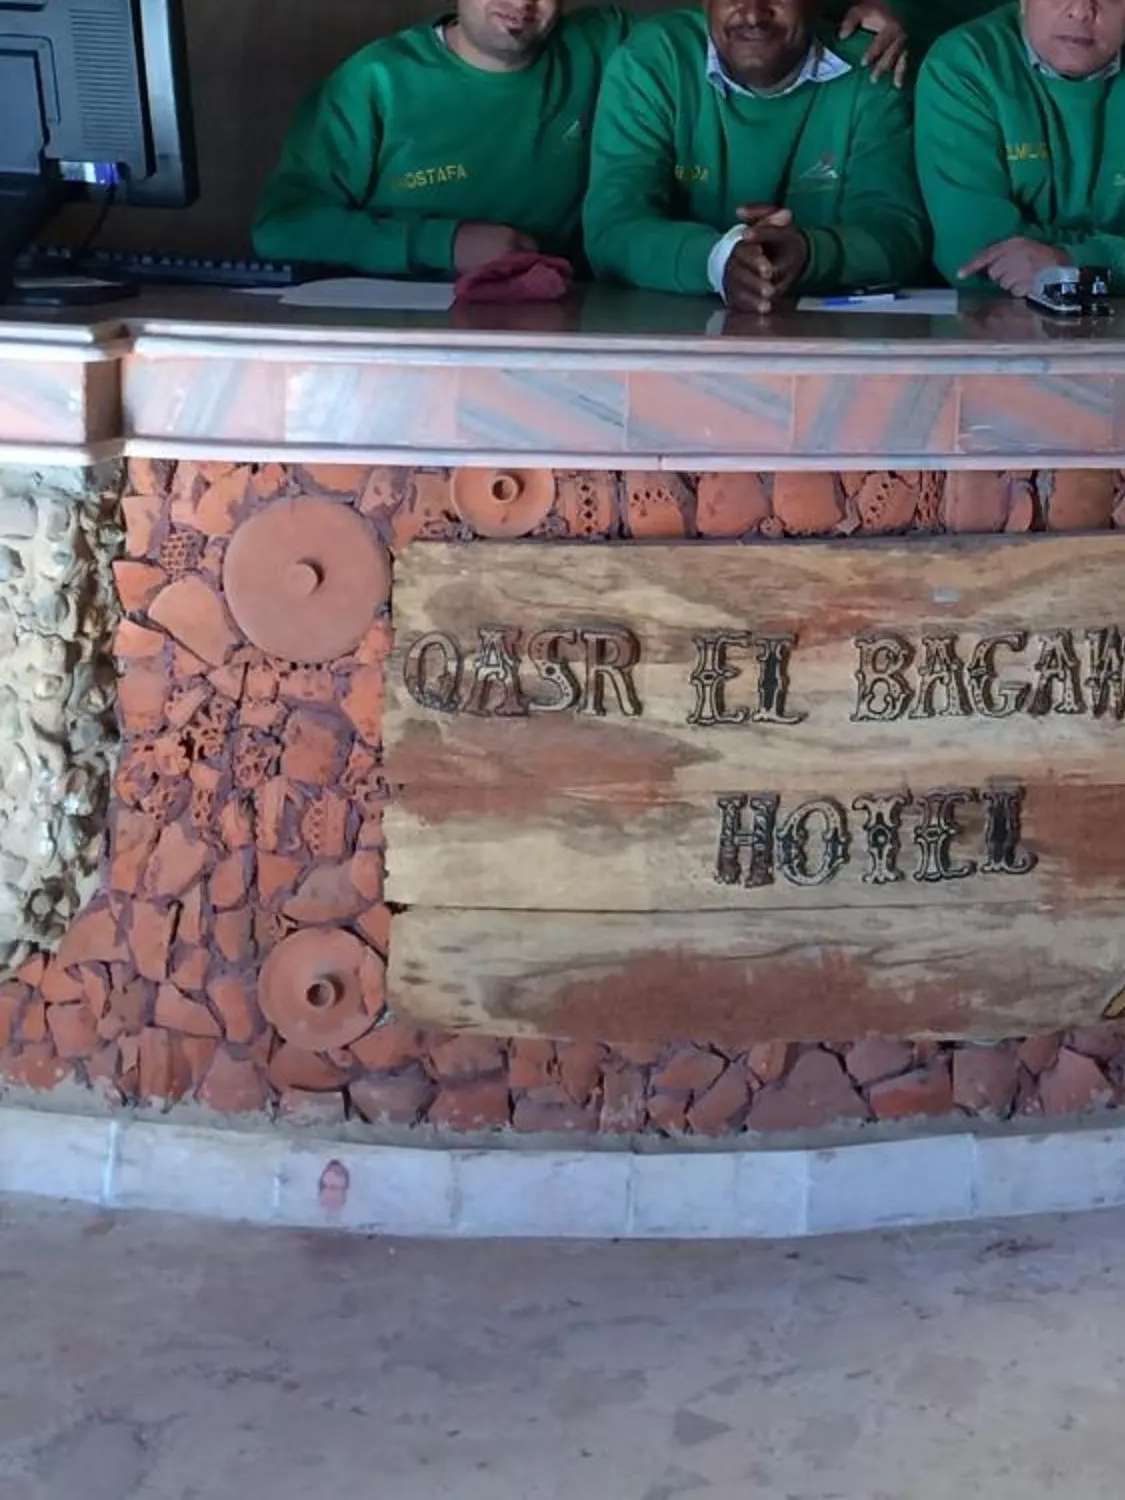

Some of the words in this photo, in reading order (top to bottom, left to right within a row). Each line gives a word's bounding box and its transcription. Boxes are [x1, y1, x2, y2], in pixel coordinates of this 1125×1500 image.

[403, 624, 644, 717] QASR
[688, 629, 818, 726] EL
[712, 776, 1039, 888] HOTEL
